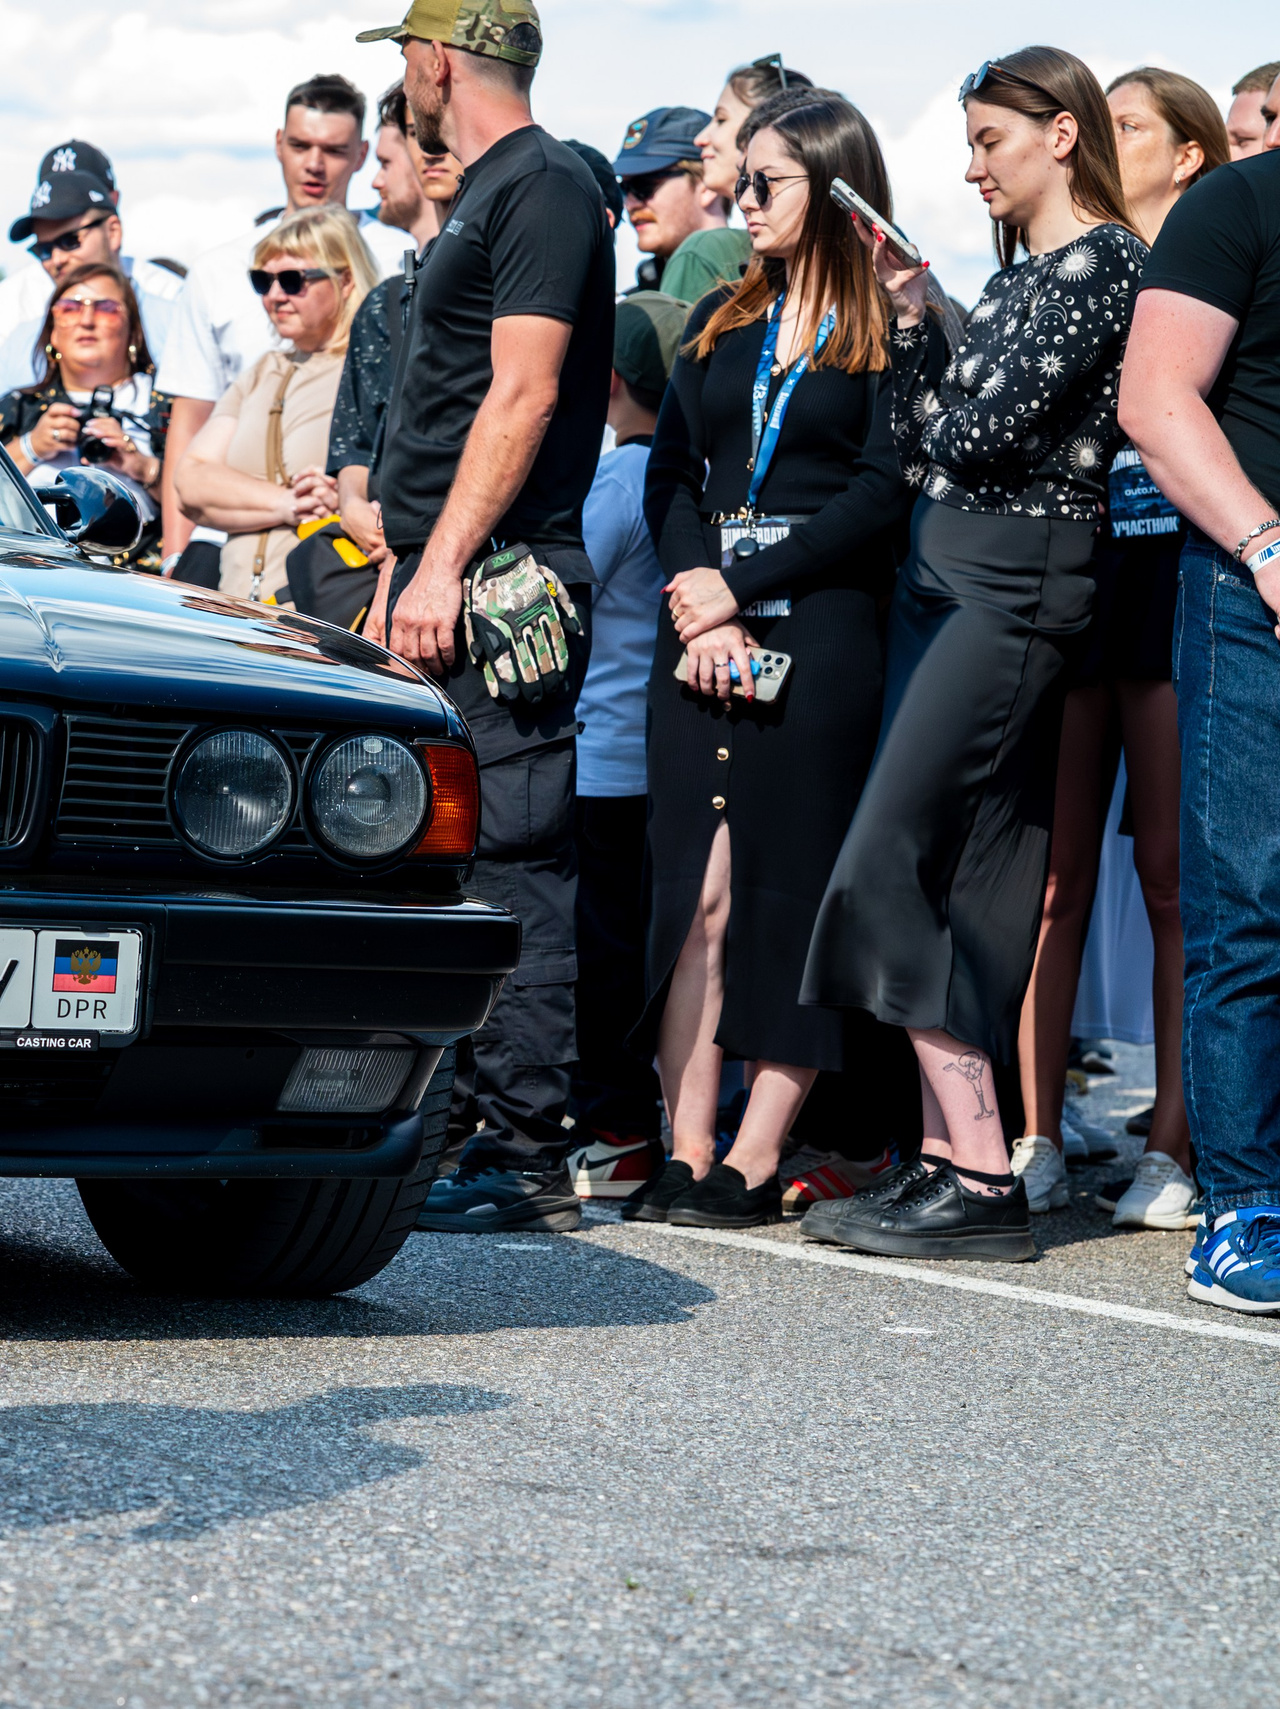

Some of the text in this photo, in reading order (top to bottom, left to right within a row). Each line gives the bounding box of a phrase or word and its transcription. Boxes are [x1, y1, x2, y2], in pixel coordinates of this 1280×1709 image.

[1112, 516, 1179, 538] УЧАСТНИК
[56, 998, 108, 1021] DPR
[16, 1036, 66, 1048] CASTING
[68, 1038, 92, 1049] CAR
